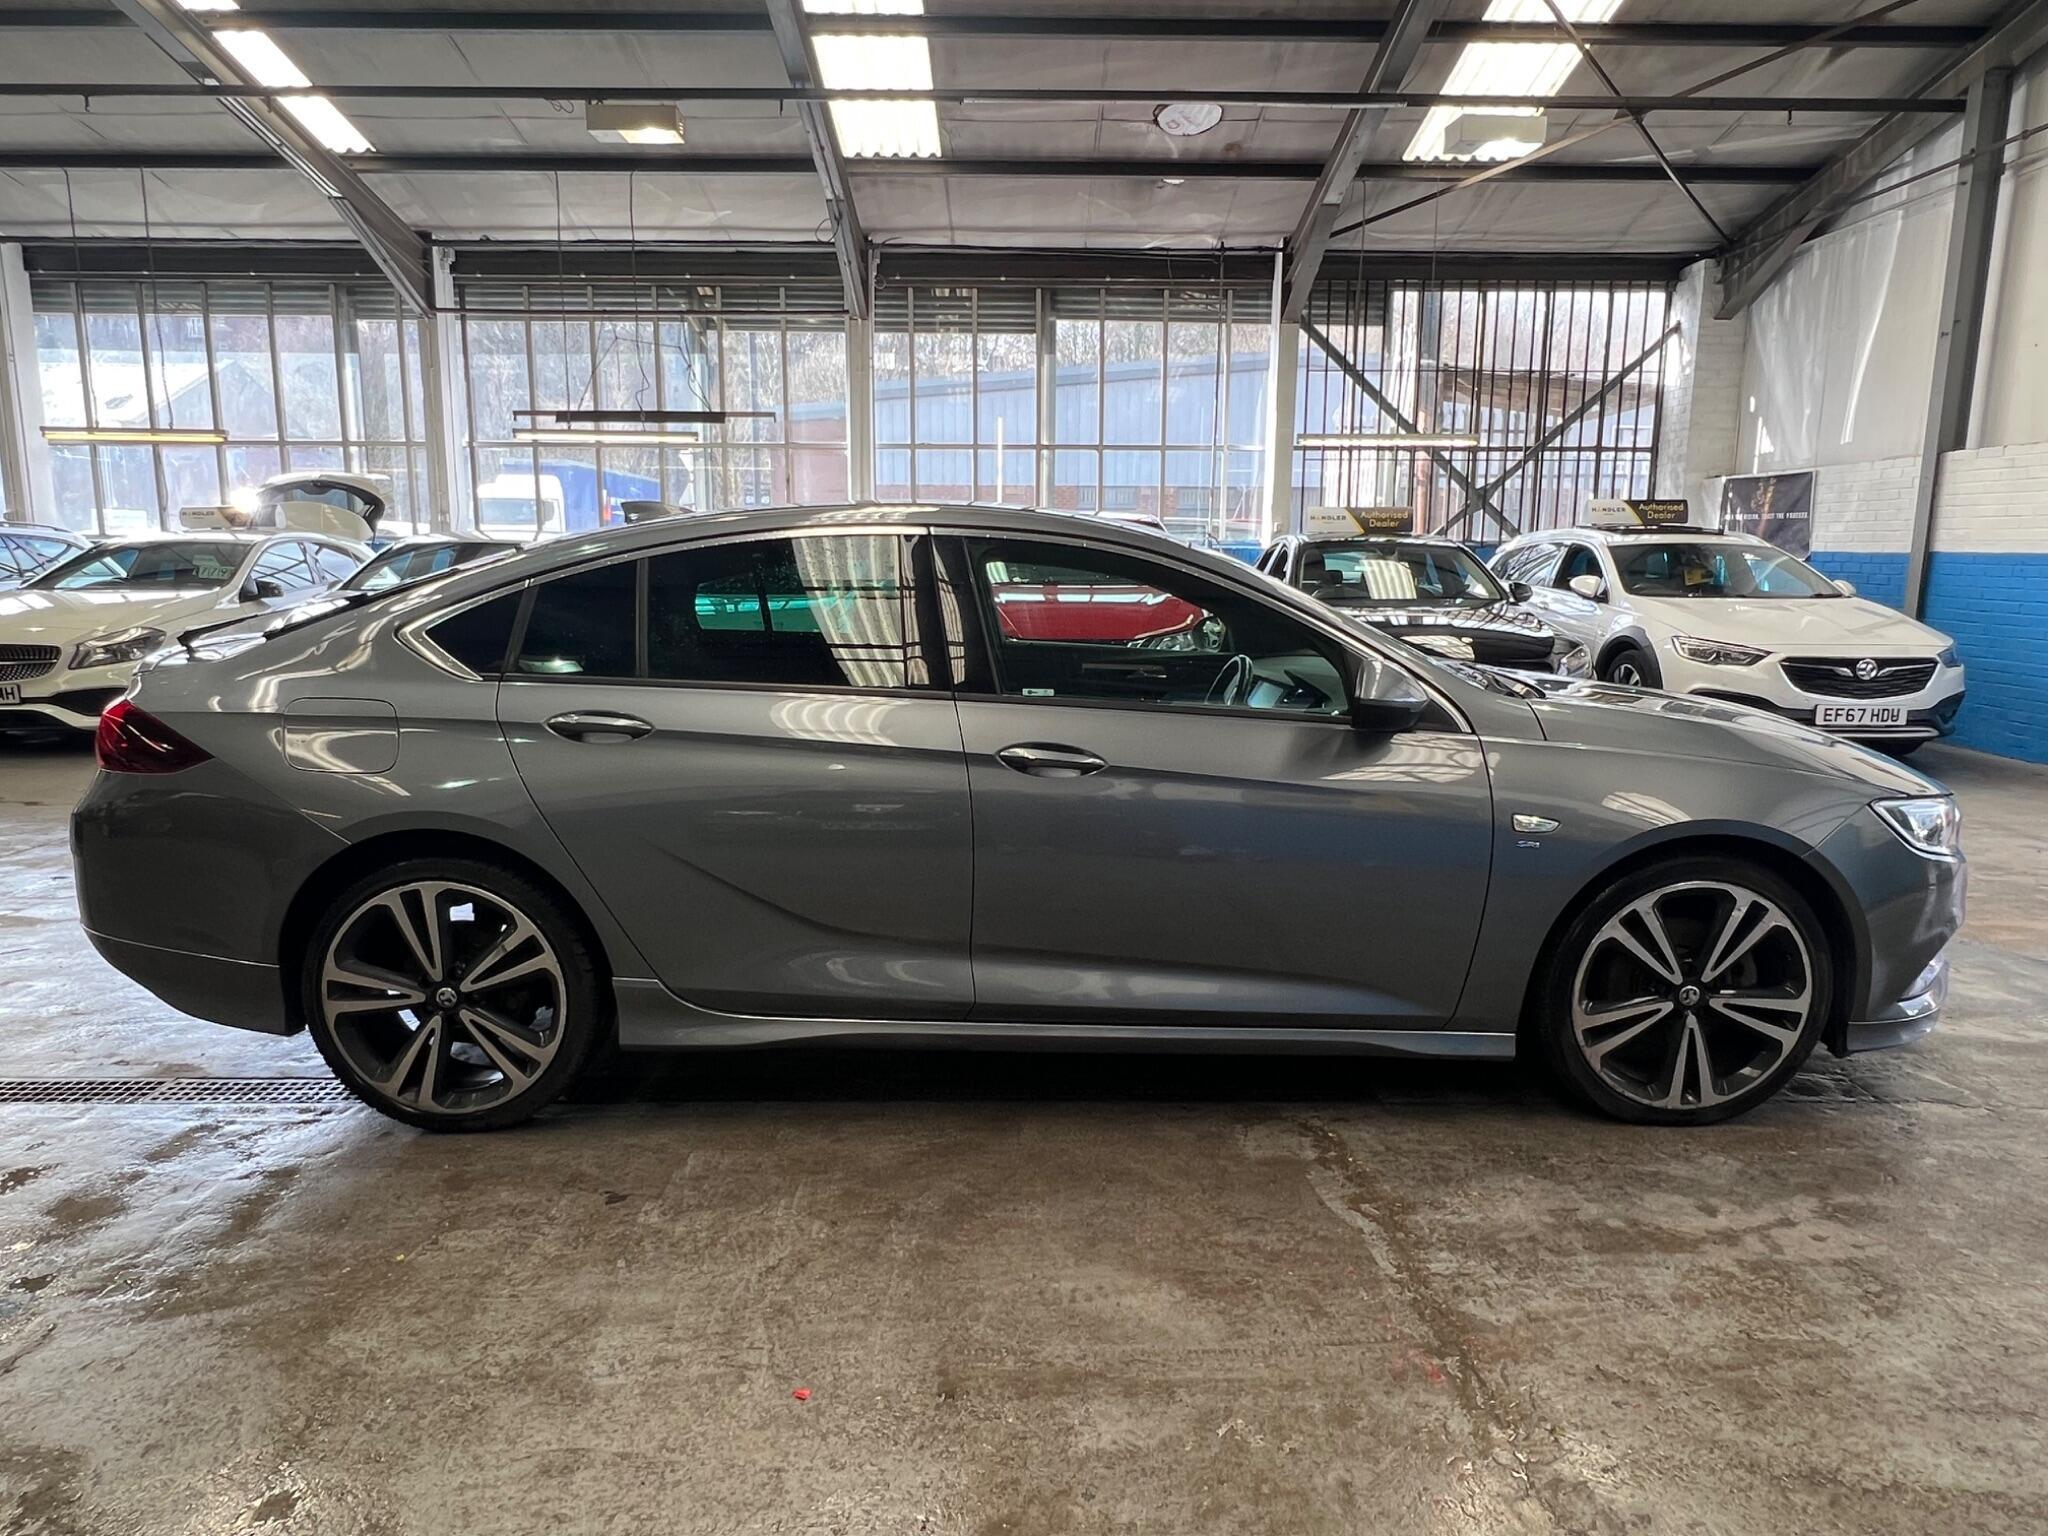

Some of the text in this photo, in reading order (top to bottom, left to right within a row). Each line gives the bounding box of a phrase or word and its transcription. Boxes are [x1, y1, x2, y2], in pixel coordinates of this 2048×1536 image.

[1639, 503, 1684, 511] Authorised
[1360, 511, 1409, 519] Authorised
[1647, 511, 1675, 519] Dealer
[1369, 519, 1400, 528] Dealer
[1823, 708, 1901, 722] EF67 HDU
